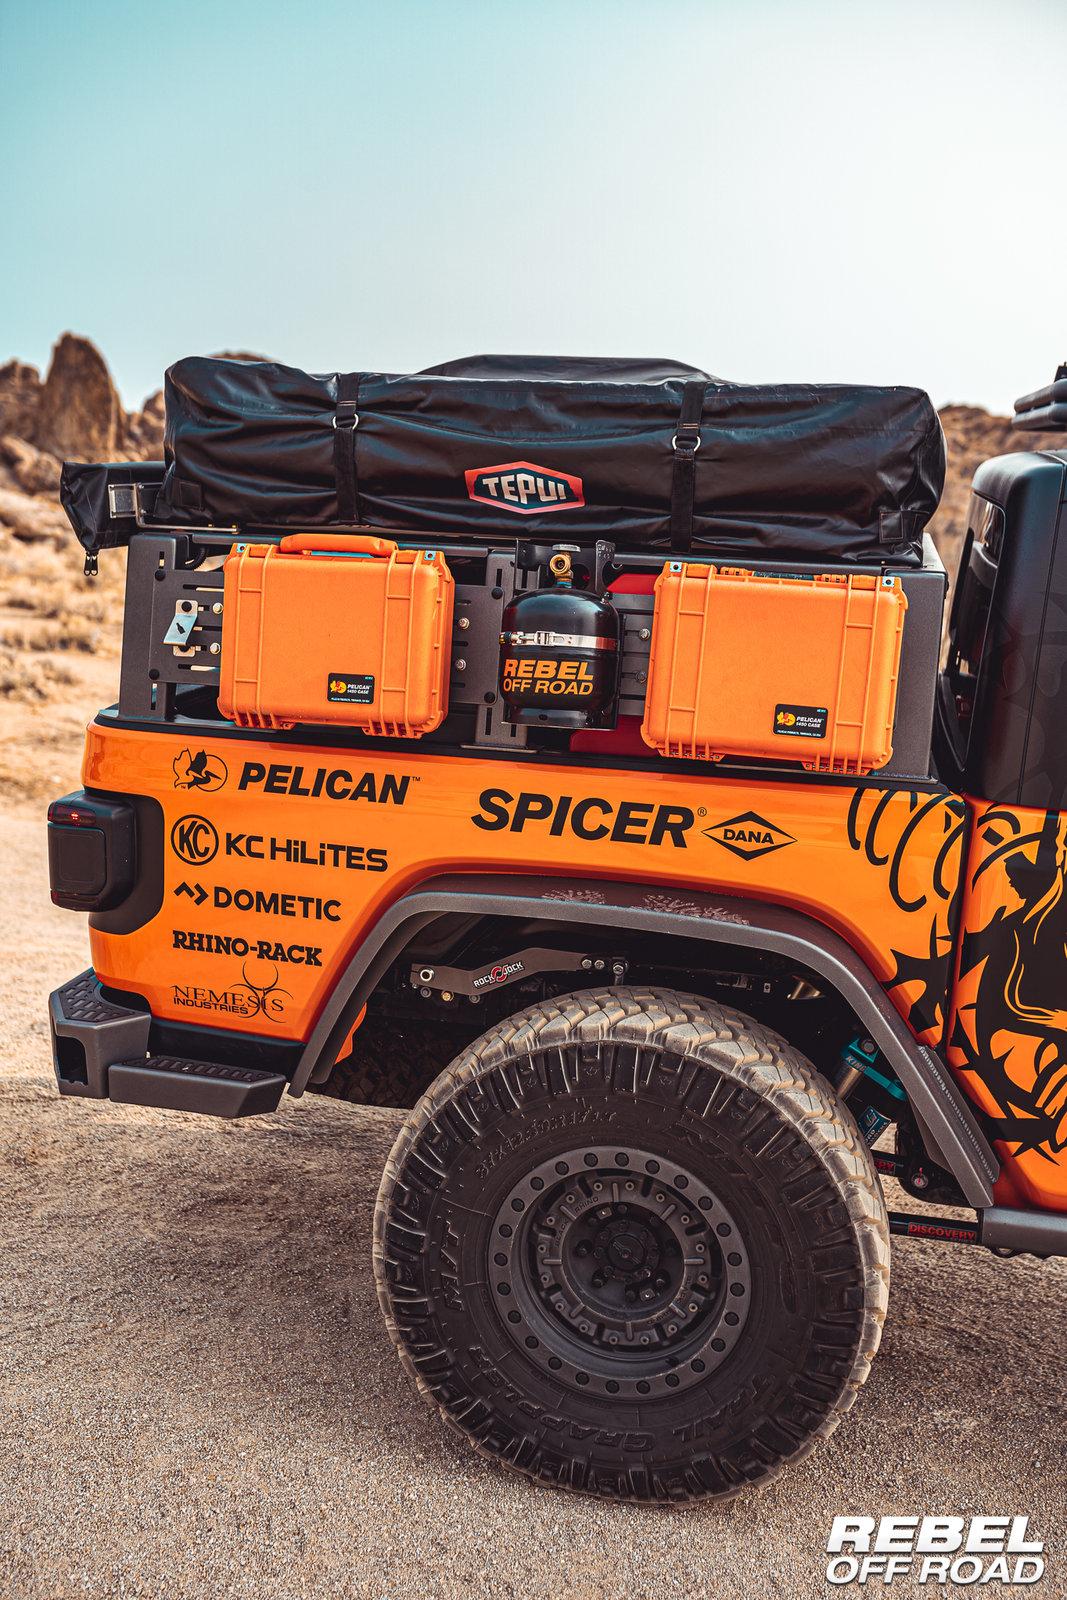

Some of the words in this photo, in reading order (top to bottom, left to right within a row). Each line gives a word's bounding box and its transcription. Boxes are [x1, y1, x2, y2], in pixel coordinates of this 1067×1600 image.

[482, 473, 567, 505] TEPUI
[503, 658, 594, 681] REBEL
[503, 677, 533, 694] OFF
[534, 679, 594, 696] ROAD
[178, 820, 210, 860] KC
[225, 832, 265, 859] KC
[722, 828, 775, 845] DANA
[213, 886, 342, 922] DOMETIC
[172, 929, 323, 967] RHINO-RACK
[473, 974, 495, 988] ROCK
[503, 961, 524, 975] JOCK
[170, 985, 285, 1012] NEMESIS
[173, 997, 249, 1015] INDUSTRIES
[574, 1195, 600, 1213] RHINO
[909, 1222, 975, 1240] DISCOVERY
